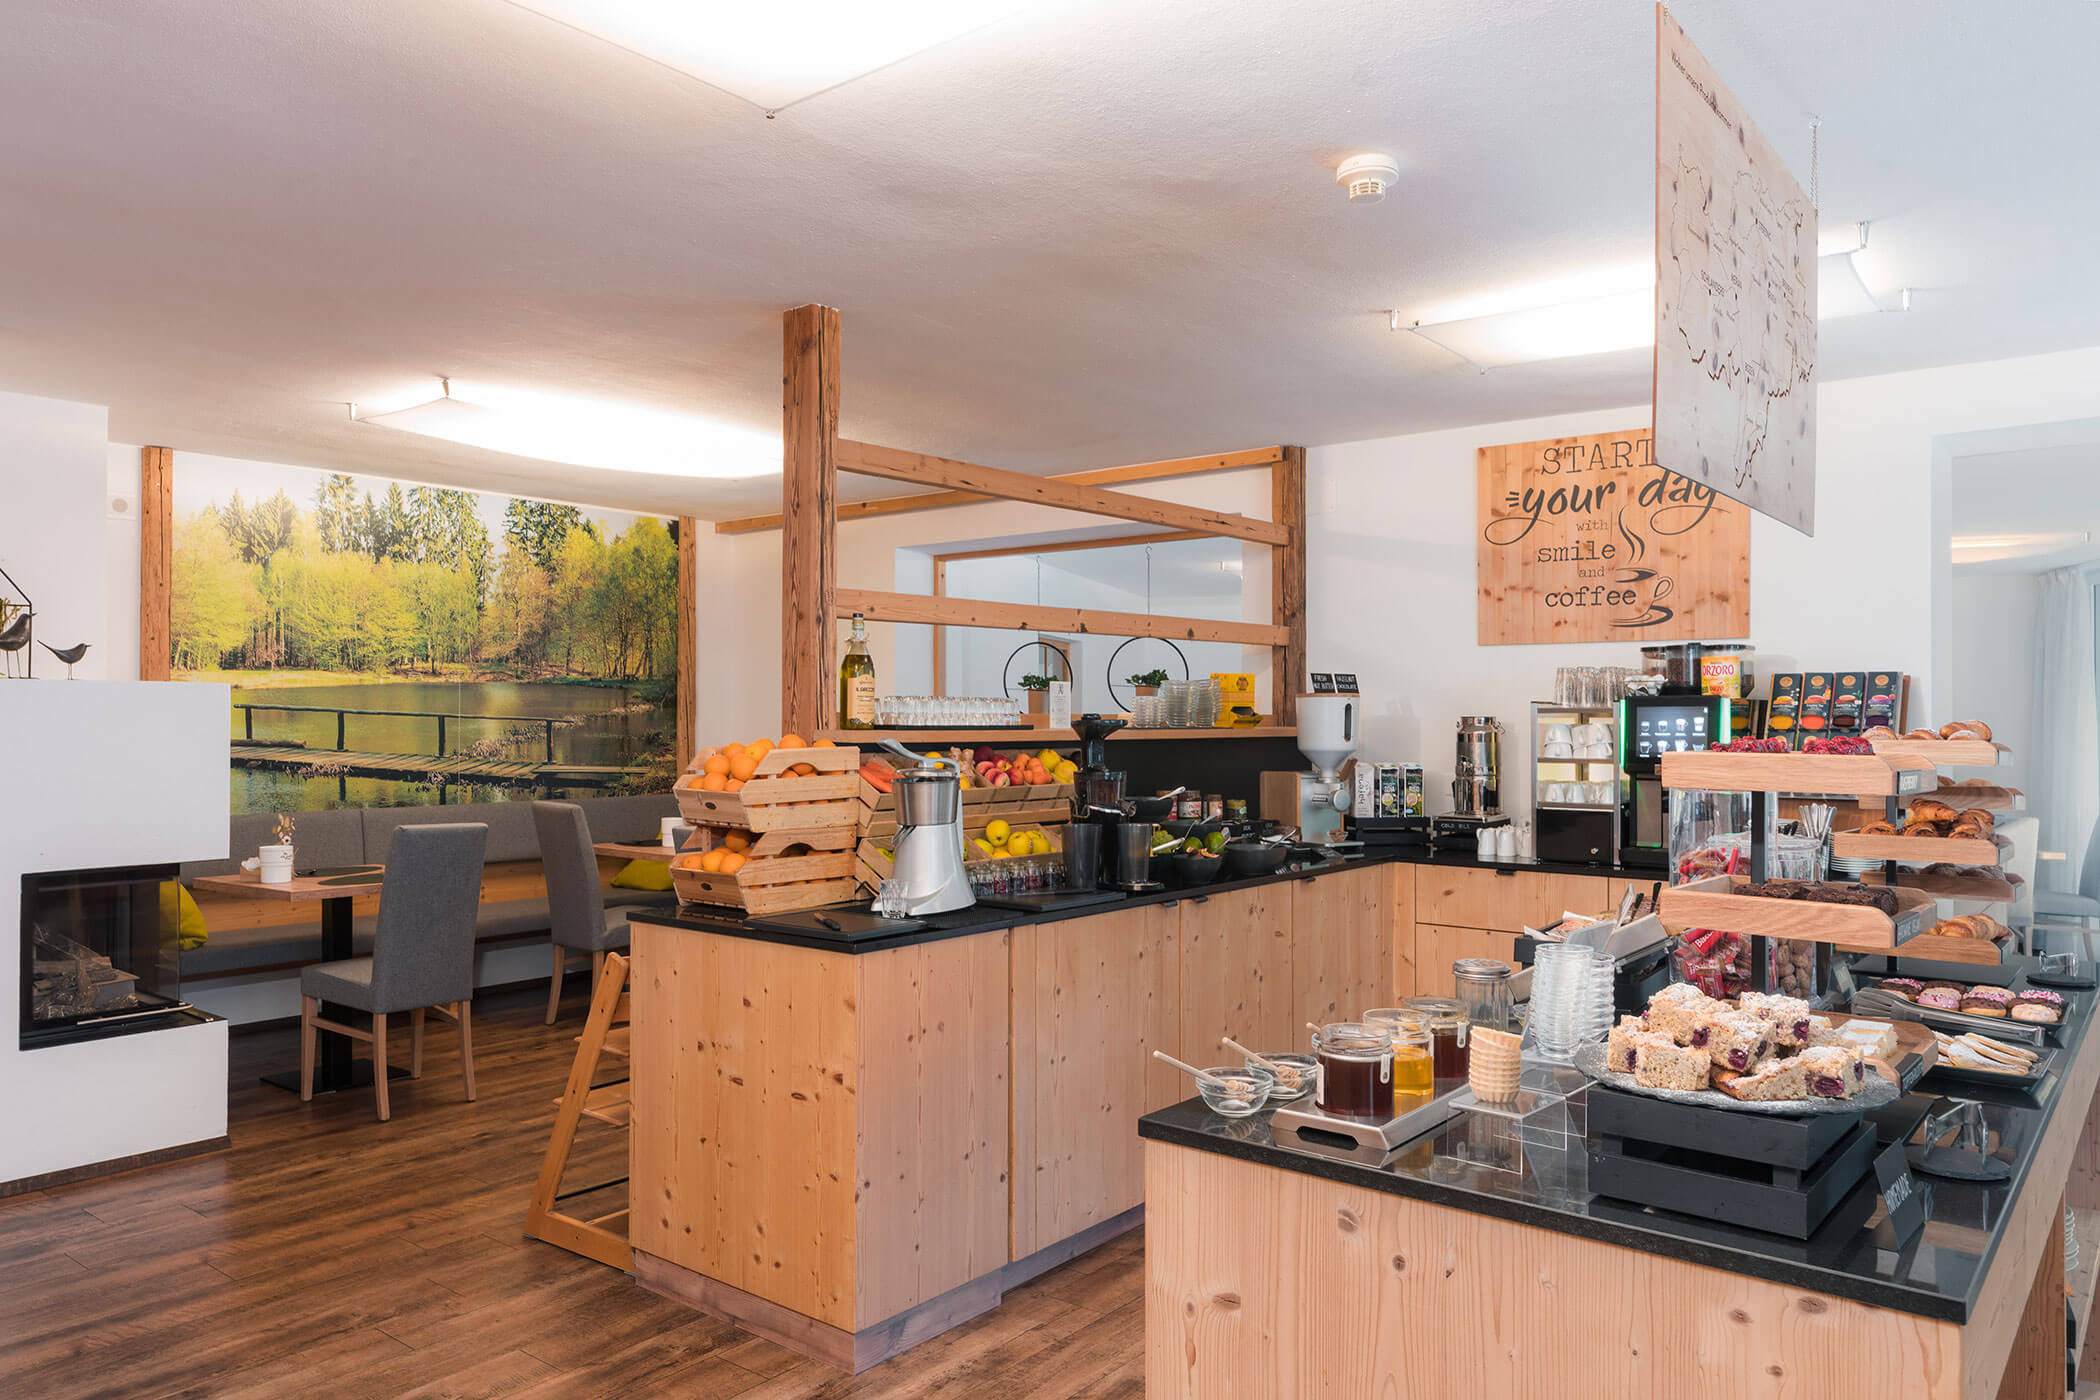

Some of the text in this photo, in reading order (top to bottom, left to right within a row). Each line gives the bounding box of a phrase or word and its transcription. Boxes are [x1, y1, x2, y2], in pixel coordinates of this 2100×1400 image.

[1541, 438, 1652, 475] START
[1485, 470, 1731, 545] your day
[1576, 519, 1609, 532] with
[1537, 540, 1616, 563] smile
[1578, 566, 1605, 578] and
[1545, 585, 1637, 608] coffee
[1702, 663, 1735, 677] ORZORO
